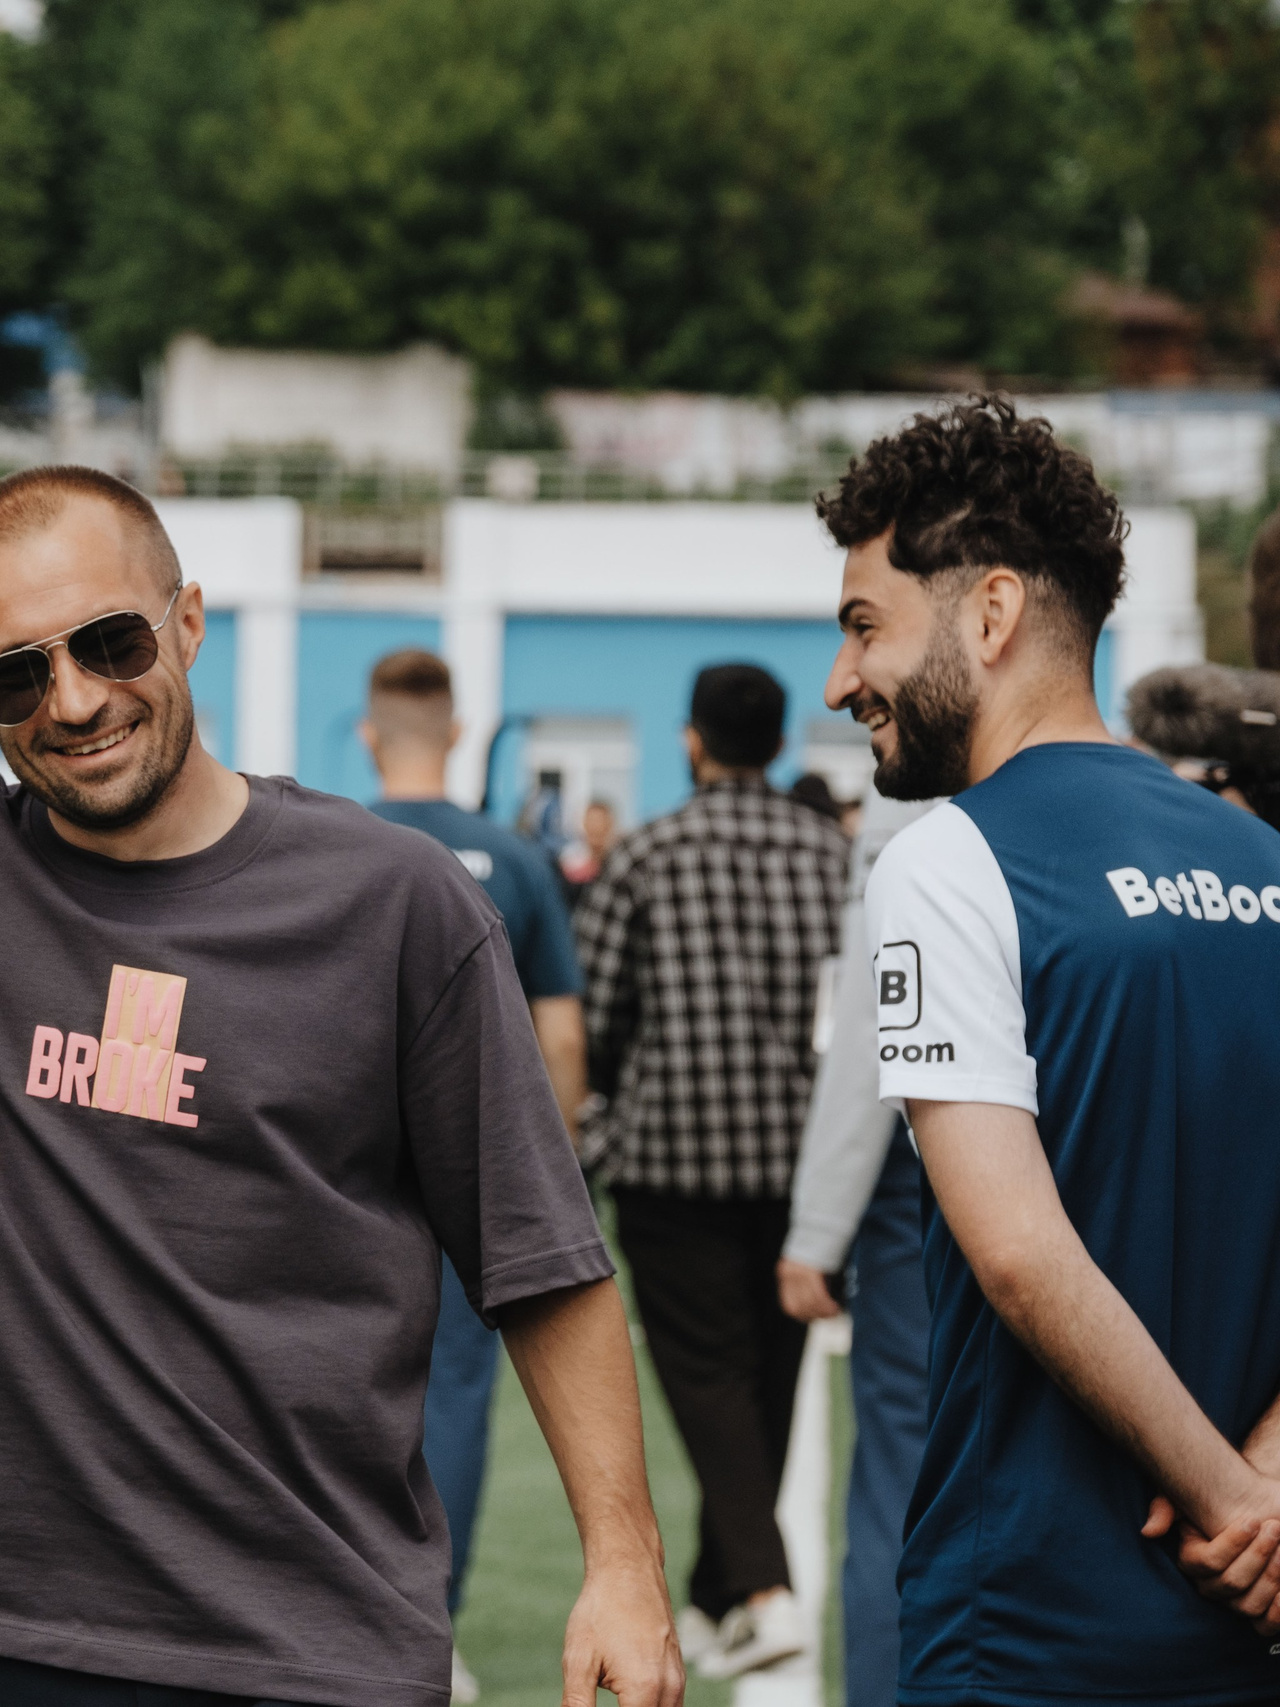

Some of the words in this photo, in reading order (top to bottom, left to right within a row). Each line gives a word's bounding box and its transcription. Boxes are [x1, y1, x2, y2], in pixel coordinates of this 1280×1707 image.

[1105, 866, 1280, 924] BetBoo
[105, 970, 183, 1051] I'M
[25, 1024, 207, 1128] BROKE
[880, 1042, 956, 1063] oom
